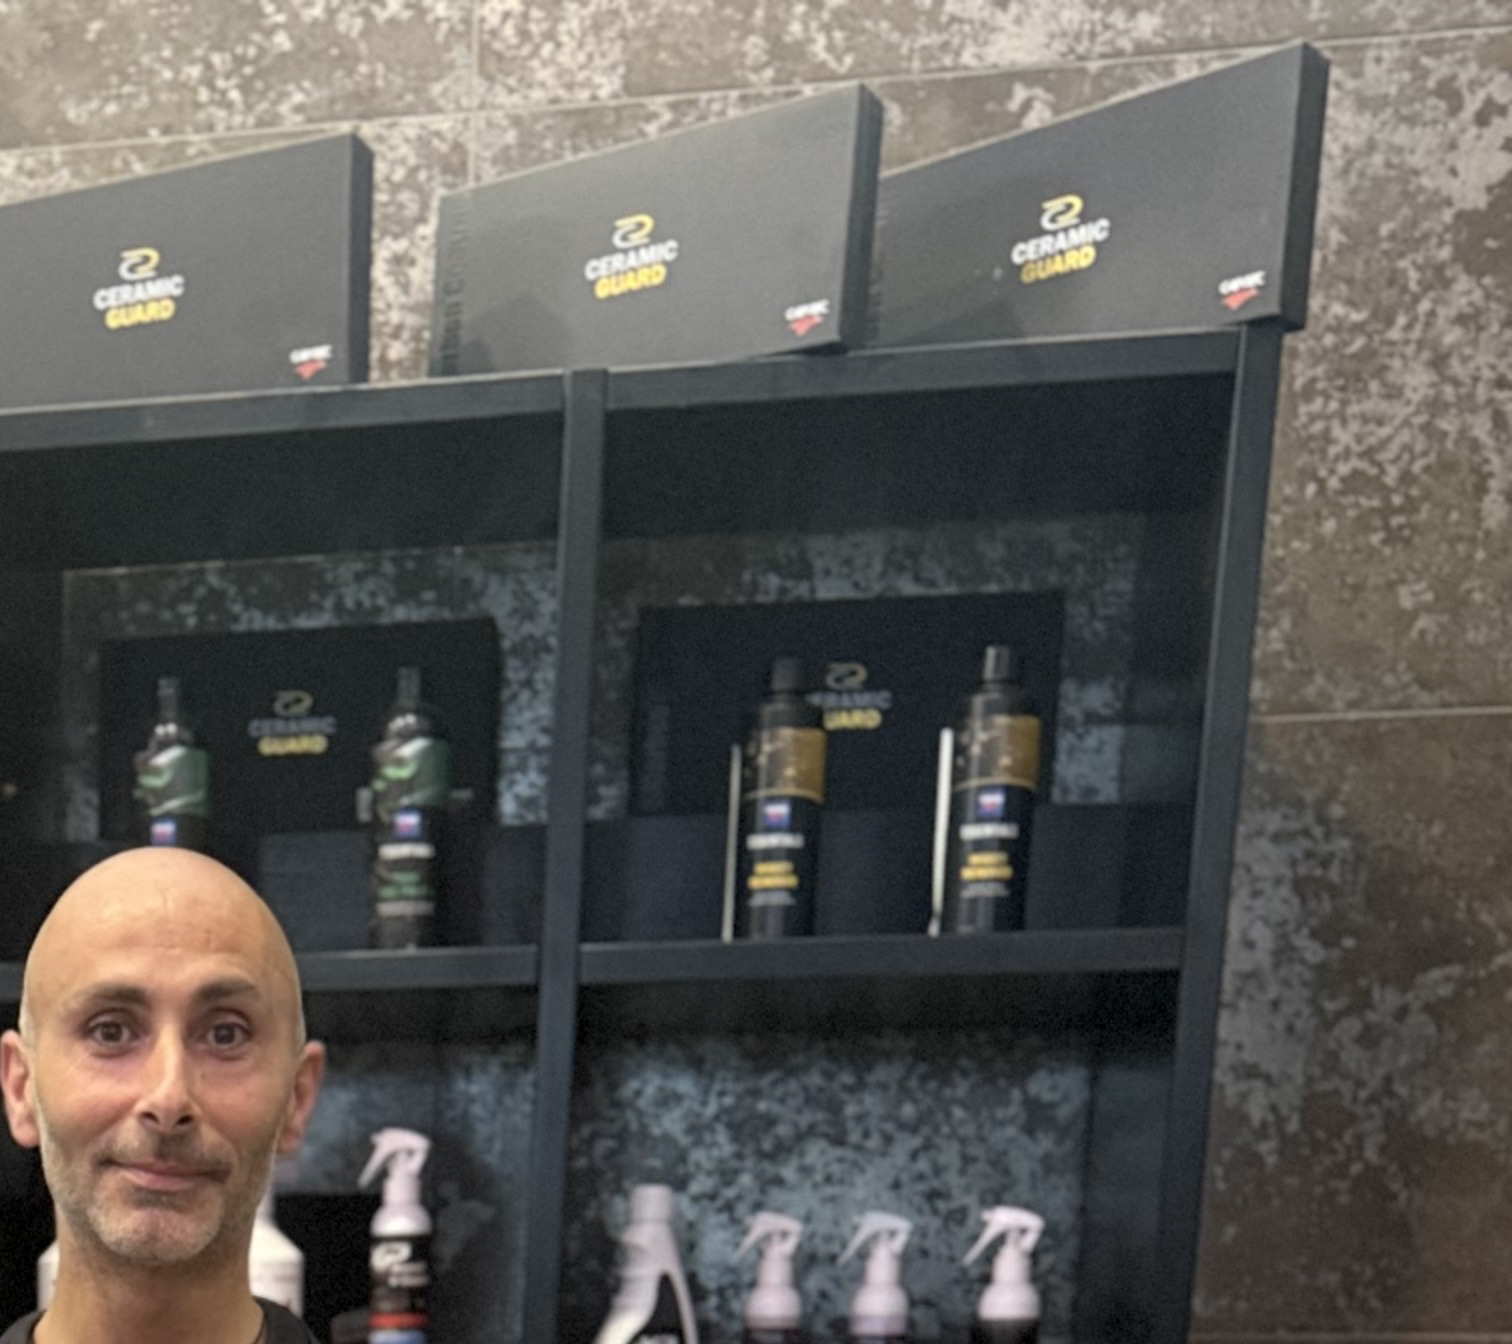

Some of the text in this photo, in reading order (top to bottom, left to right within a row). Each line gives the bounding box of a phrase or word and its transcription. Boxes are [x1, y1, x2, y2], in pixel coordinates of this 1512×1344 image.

[584, 238, 680, 281] CERAMIC
[1010, 217, 1111, 266] CERAMIC
[594, 262, 667, 300] GUARD
[1020, 243, 1097, 285] GUARD
[92, 273, 185, 311] CERAMIC
[105, 298, 176, 330] GUARD
